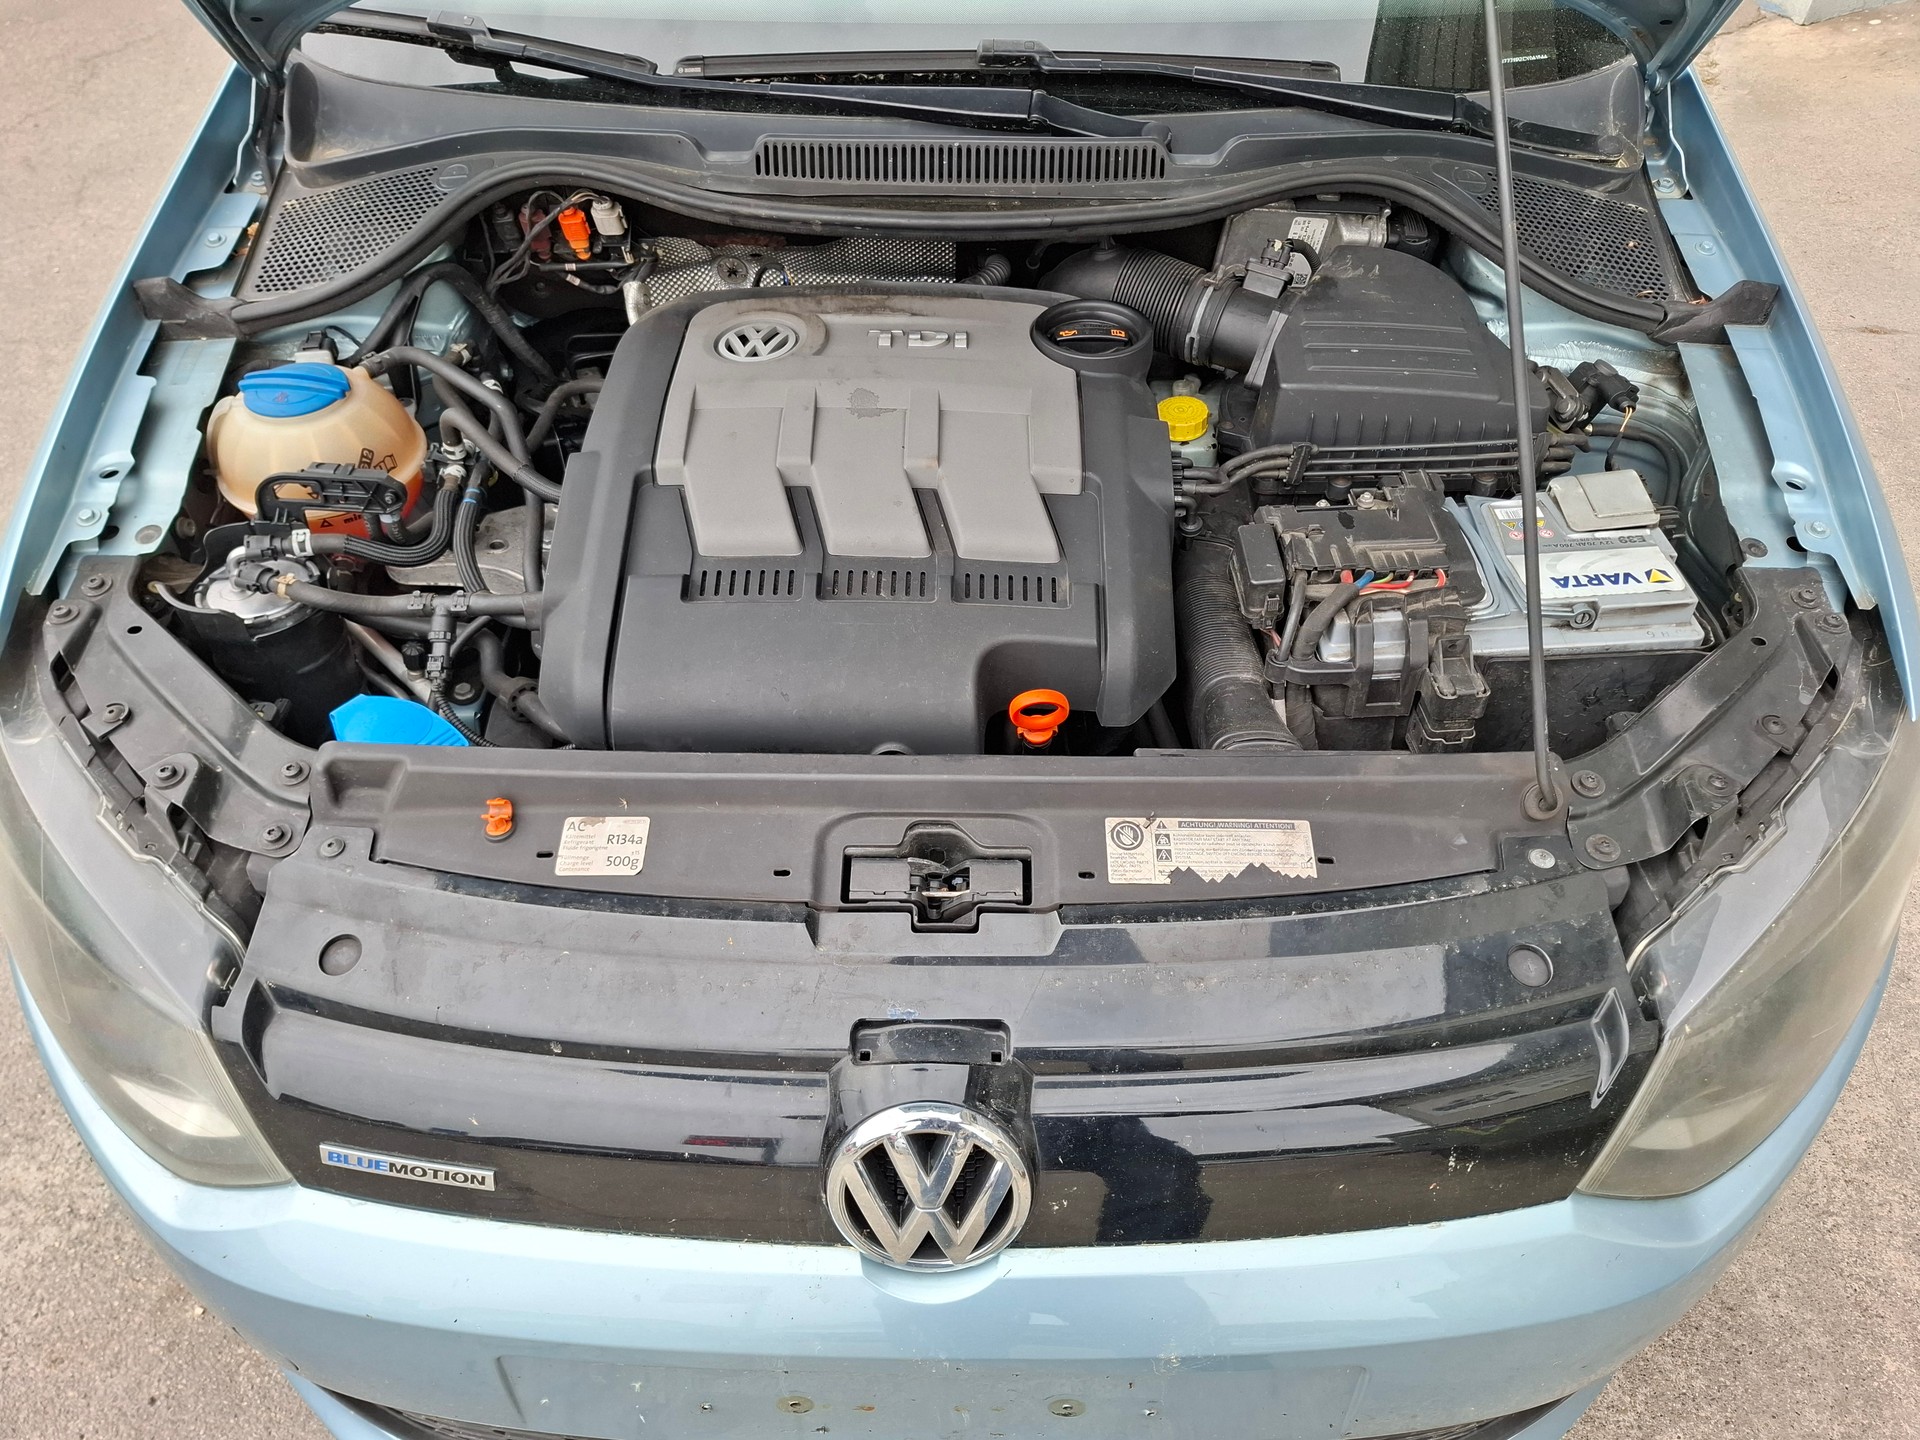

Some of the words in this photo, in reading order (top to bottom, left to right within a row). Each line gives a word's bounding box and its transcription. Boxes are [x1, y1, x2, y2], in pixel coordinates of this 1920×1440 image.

[868, 329, 967, 349] TDI
[1618, 535, 1646, 544] E39
[1550, 572, 1643, 589] VARTA
[567, 821, 586, 832] AC
[607, 834, 643, 845] R134a
[606, 856, 639, 870] 500g
[327, 1151, 486, 1186] BLUEMOTION
[837, 1121, 1022, 1269] VW
